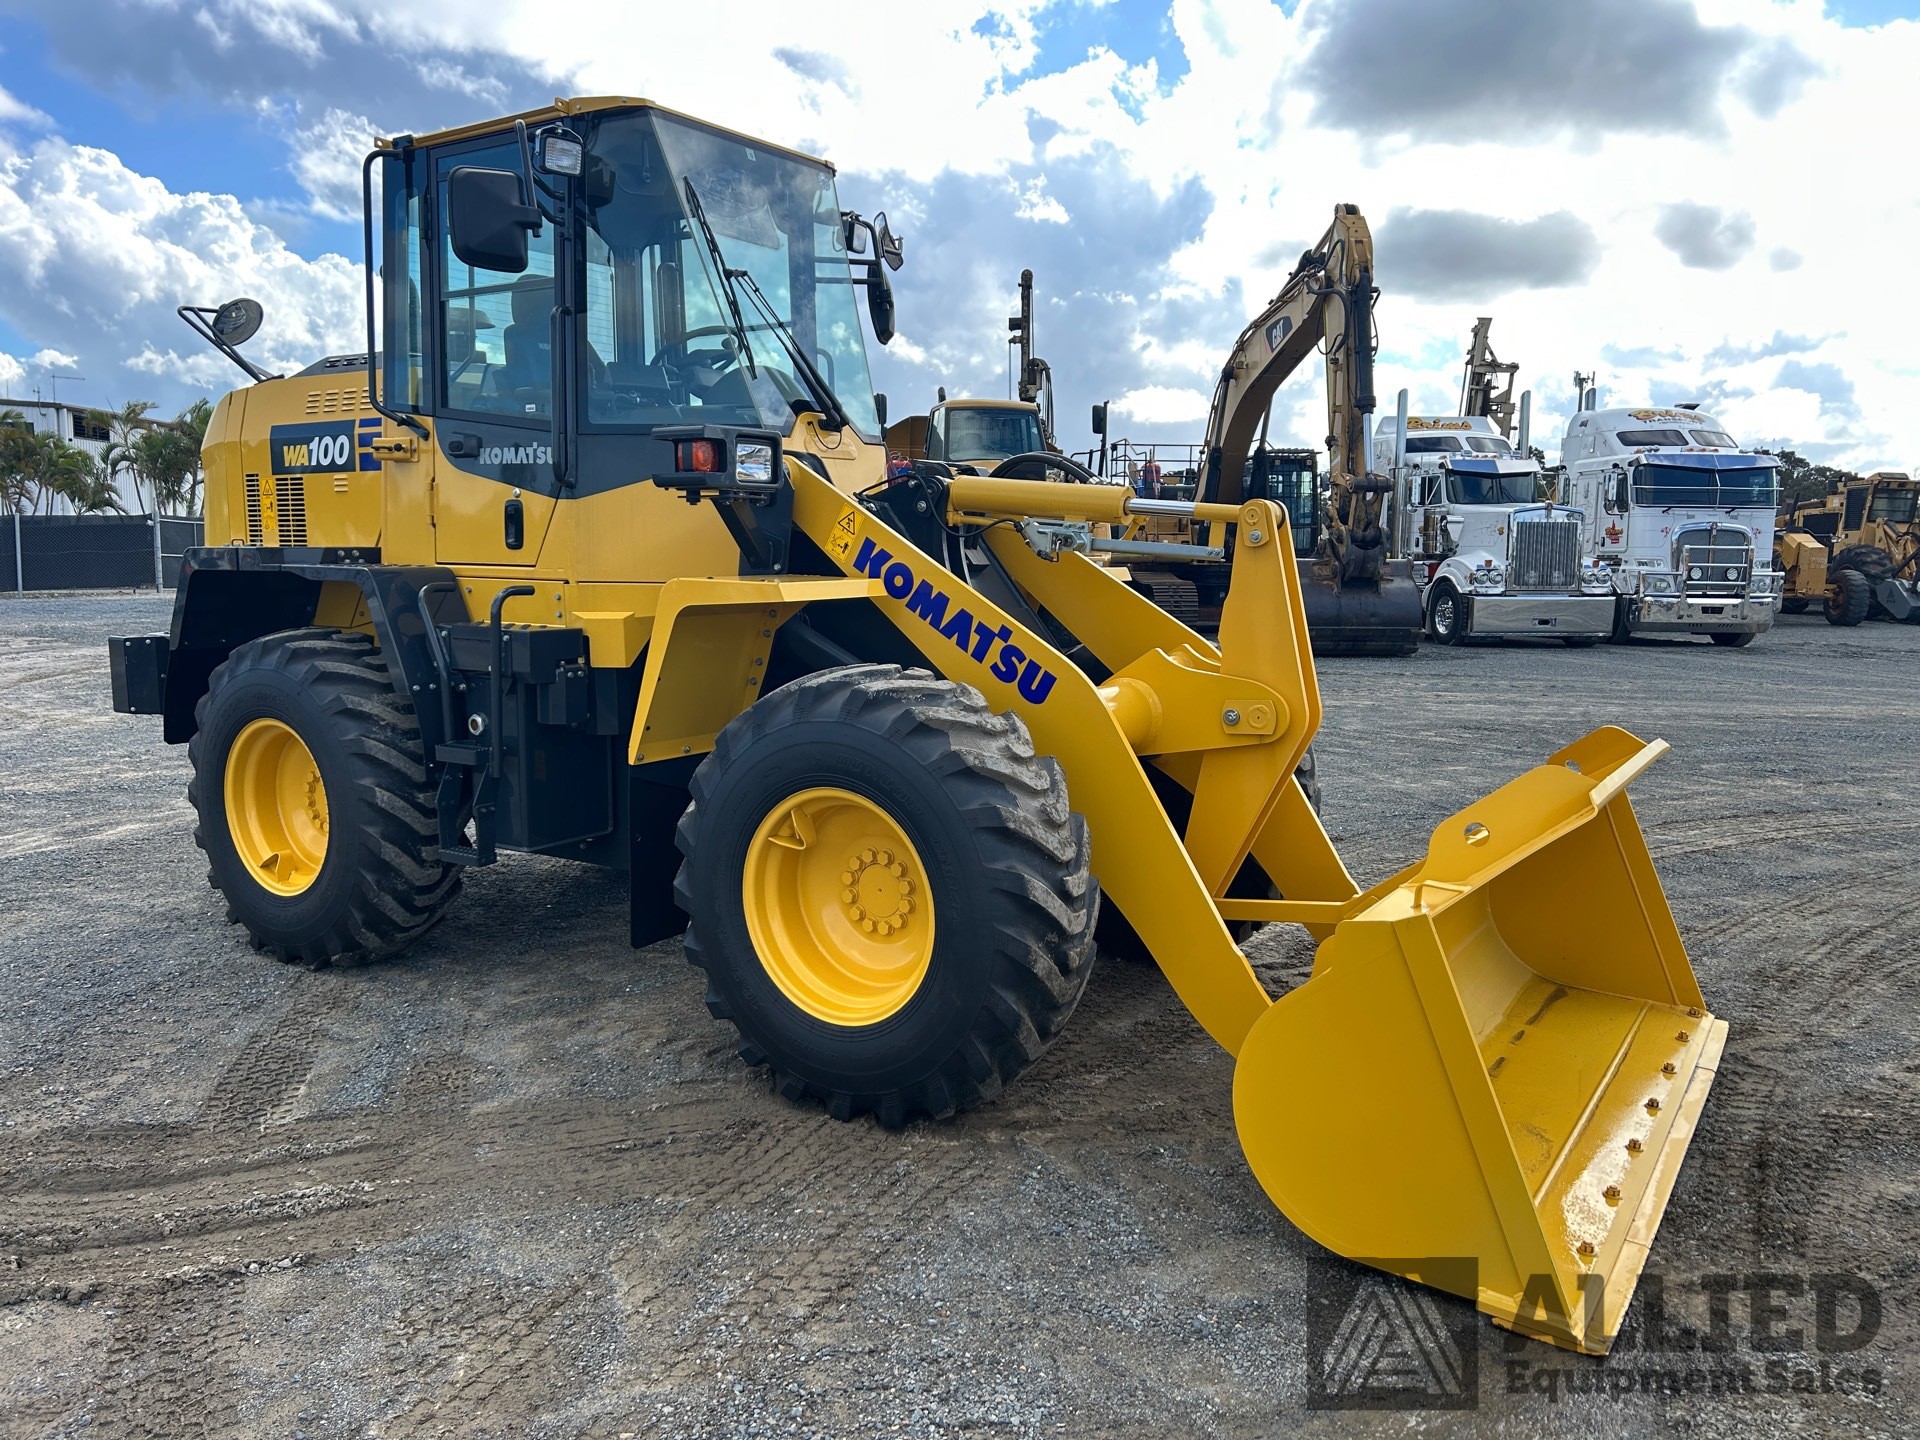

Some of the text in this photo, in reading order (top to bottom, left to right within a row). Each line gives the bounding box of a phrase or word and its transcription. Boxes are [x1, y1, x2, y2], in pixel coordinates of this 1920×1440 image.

[1272, 318, 1284, 349] CAT
[282, 434, 350, 467] WA100
[852, 536, 1058, 705] KOMATSU
